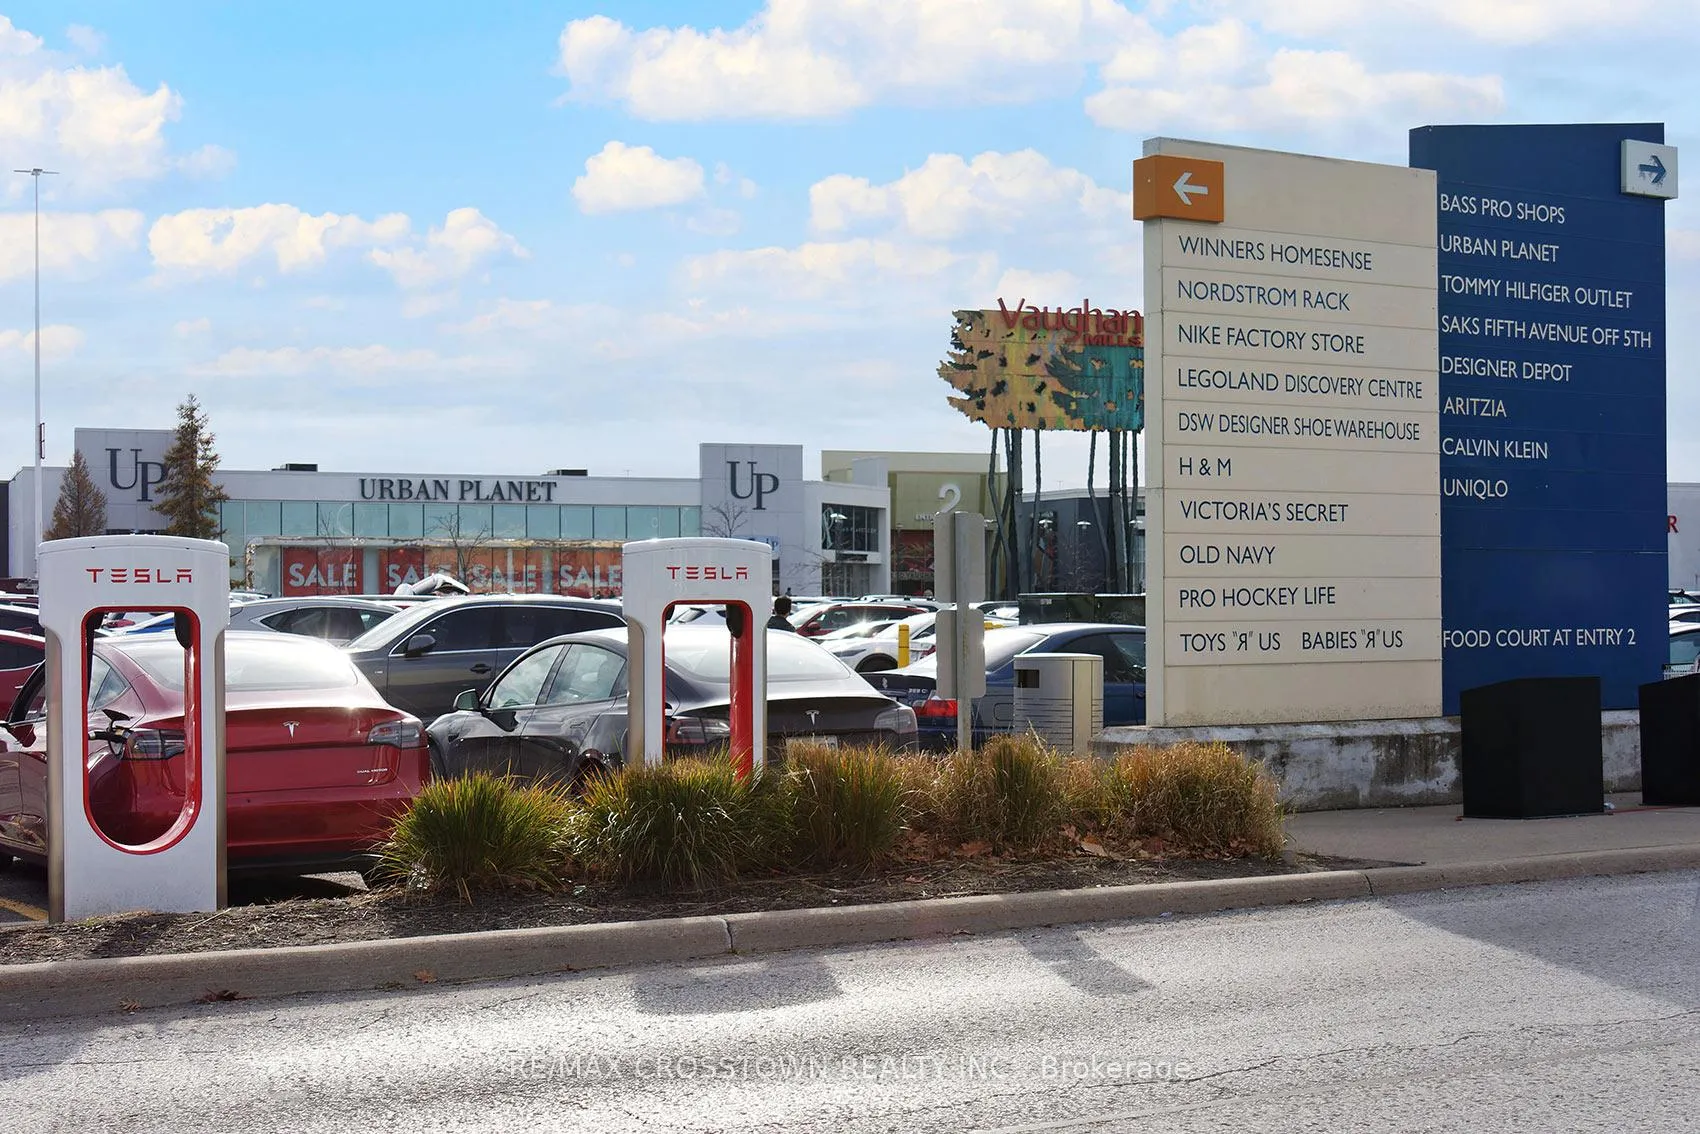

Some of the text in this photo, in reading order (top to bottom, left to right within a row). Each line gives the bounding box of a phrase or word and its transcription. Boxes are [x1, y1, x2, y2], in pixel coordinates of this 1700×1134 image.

[1440, 193, 1566, 224] BASS PRO SHOPS
[1178, 235, 1373, 270] WINNERS HOMESENSE
[1440, 234, 1560, 263] URBAN PLANET
[1178, 280, 1350, 311] NORDSTROM RACK
[1441, 275, 1633, 309] TOMMY HILFIGER OUTLET
[997, 297, 1142, 344] Vaughan
[1441, 314, 1652, 349] SAKS FIFTH AVENUE OFF 5TH
[1083, 334, 1142, 347] MILLS
[1178, 324, 1365, 354] NIKE FACTORY STORE
[1441, 356, 1573, 382] DESIGNER DEPOT
[1178, 368, 1423, 399] LEGOLAND DISCOVERY CENTRE
[1443, 396, 1507, 418] ARITZIA
[1178, 413, 1420, 441] DSW DESIGNER SHOE WAREHOUSE
[1441, 437, 1548, 460] CALVIN KLEIN
[105, 448, 168, 502] UP
[1179, 457, 1232, 477] H & M
[359, 478, 558, 502] URBAN PLANET
[726, 460, 780, 511] UP
[1443, 478, 1508, 501] UNIQLO
[1180, 500, 1349, 522] VICTORIA'S SECRET
[1180, 545, 1276, 565] OLD NAVY
[86, 568, 193, 583] TESLA
[288, 563, 358, 588] SALE
[472, 563, 537, 589] SALE
[559, 563, 623, 588] SALE
[666, 566, 748, 580] TESLA
[1179, 586, 1336, 608] PRO HOCKEY LIFE
[1180, 633, 1226, 652] TOYS
[1258, 632, 1282, 651] US
[1302, 631, 1358, 650] BABIES
[1382, 630, 1404, 649] US
[1443, 628, 1636, 648] FOOD COURT AT ENTRY 2
